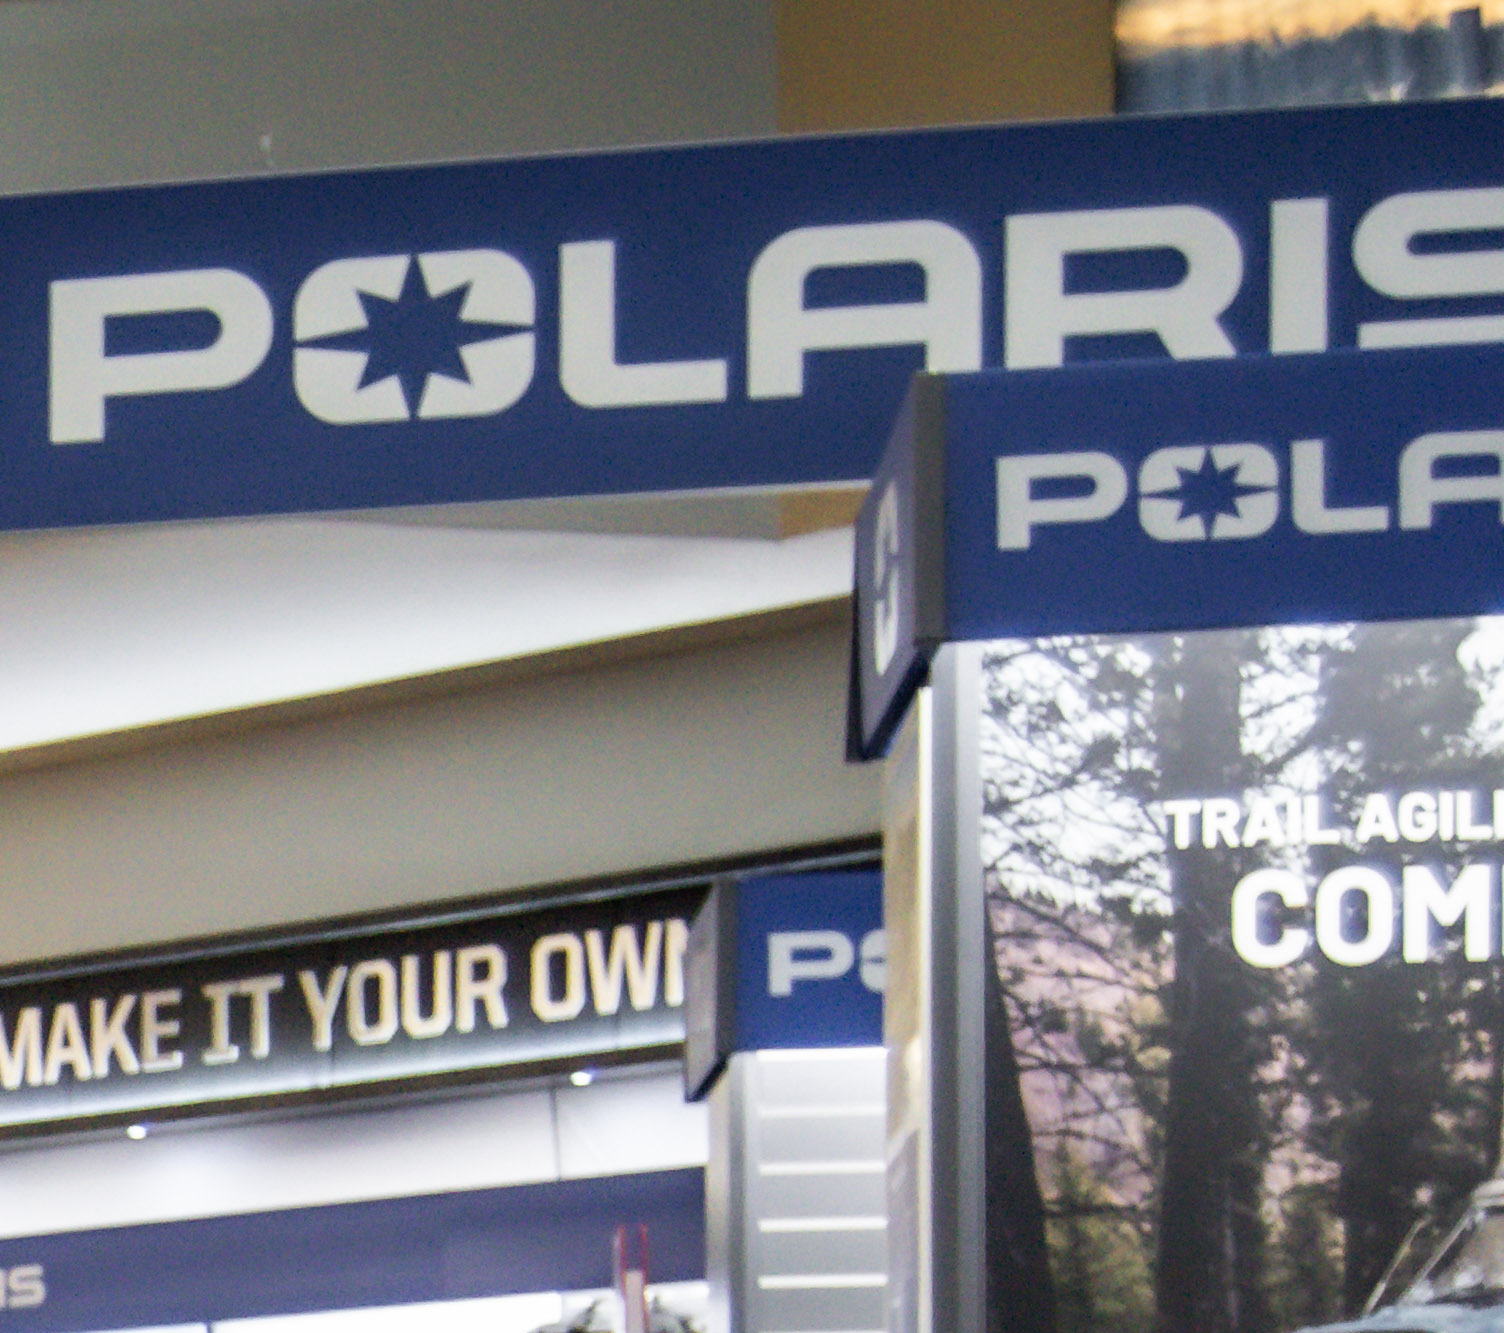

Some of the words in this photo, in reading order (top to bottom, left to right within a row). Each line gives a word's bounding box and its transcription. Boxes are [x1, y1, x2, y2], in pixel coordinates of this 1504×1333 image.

[47, 187, 1504, 445] POLARIS
[1164, 796, 1342, 851] TRAIL
[1230, 862, 1504, 969] COM
[199, 974, 285, 1064] IT
[298, 943, 510, 1054] YOUR
